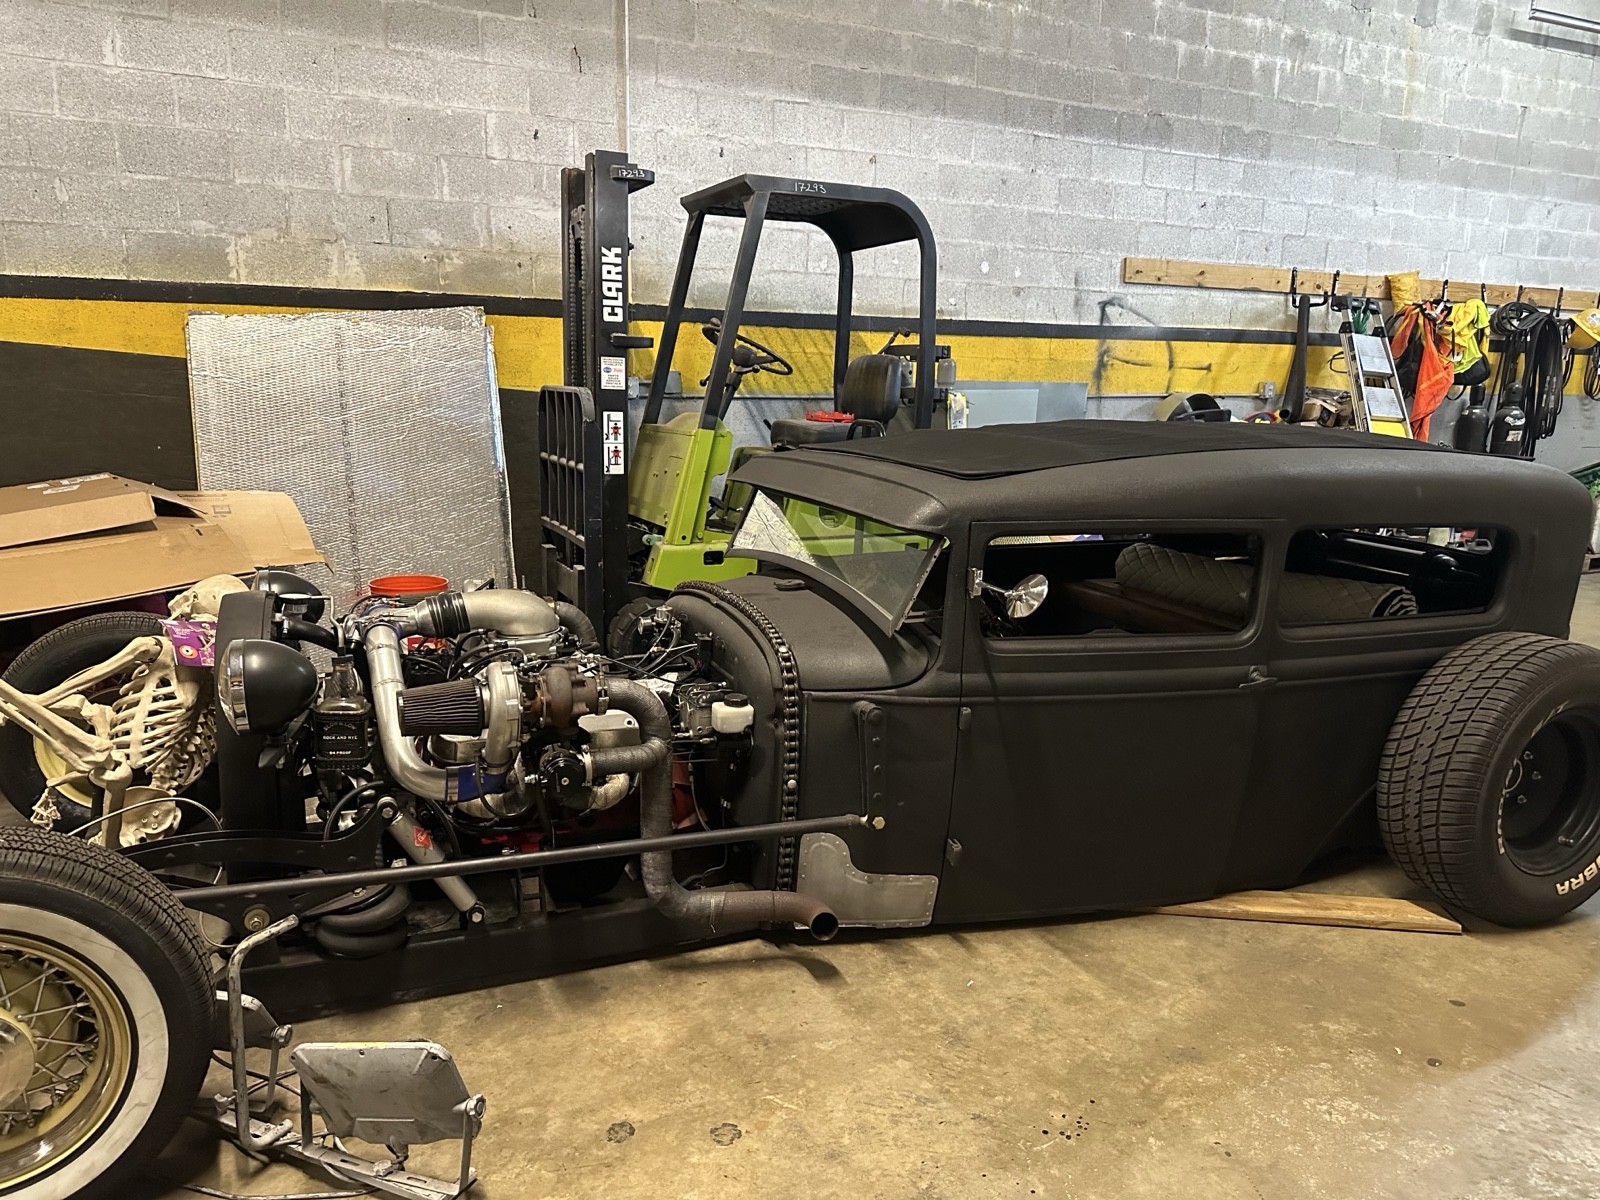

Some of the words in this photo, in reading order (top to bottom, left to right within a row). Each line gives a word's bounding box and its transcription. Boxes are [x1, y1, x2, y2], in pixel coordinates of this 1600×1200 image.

[618, 169, 645, 178] 17293
[794, 182, 827, 194] 17293
[601, 246, 624, 323] CLARK
[1555, 854, 1600, 895] BRA
